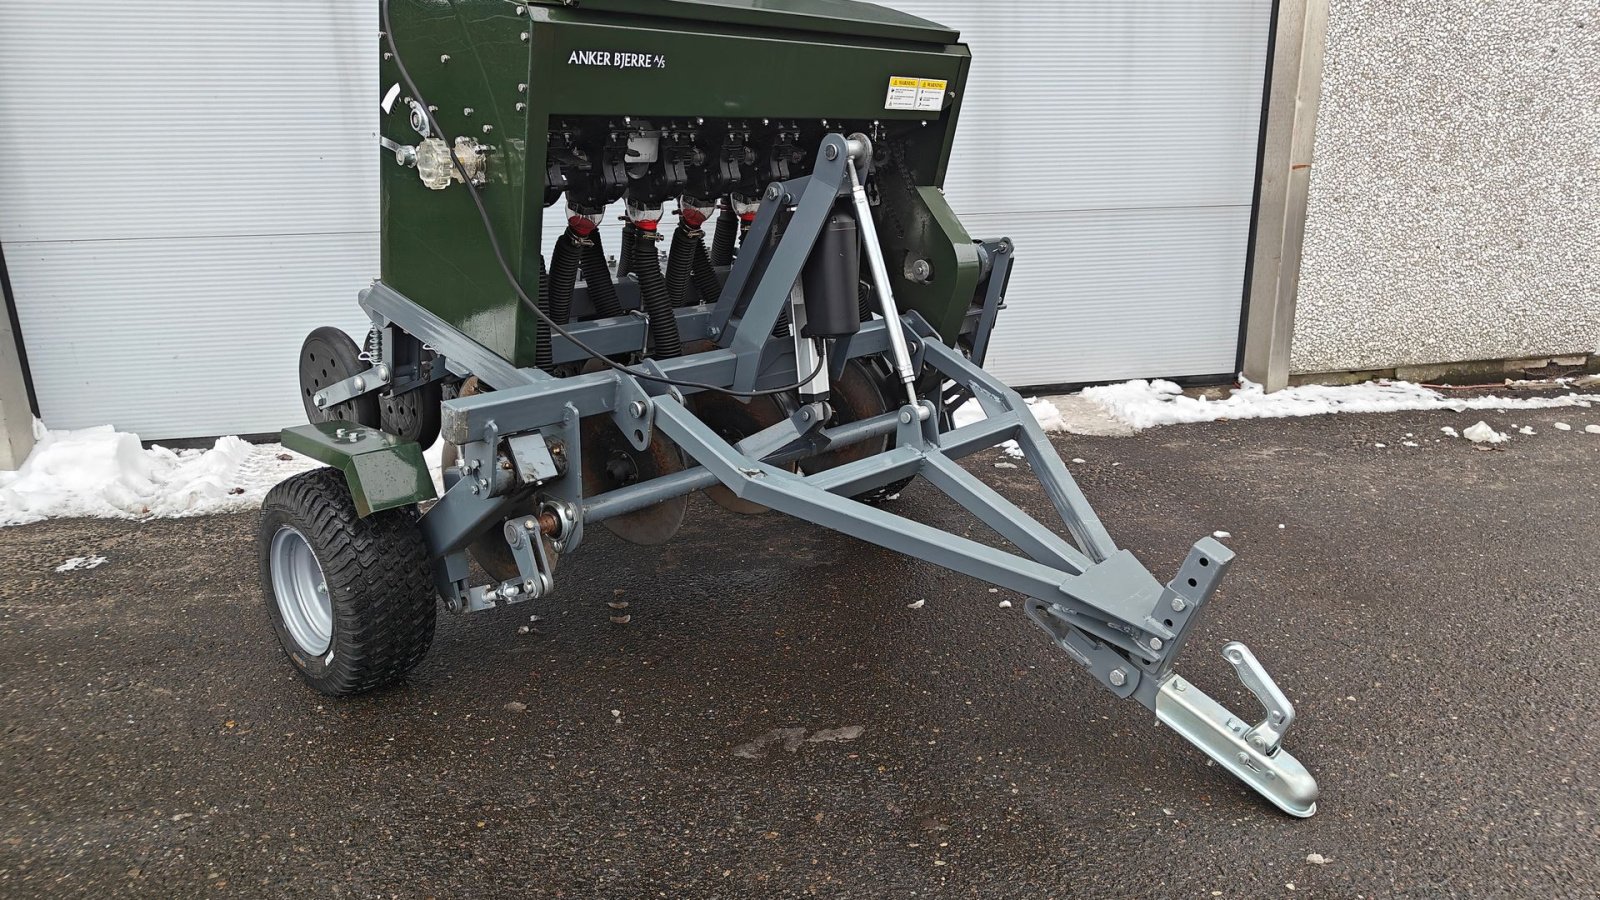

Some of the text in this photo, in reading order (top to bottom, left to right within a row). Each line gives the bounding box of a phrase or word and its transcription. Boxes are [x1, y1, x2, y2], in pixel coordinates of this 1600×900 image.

[568, 51, 665, 68] ANKER BJERRE A/S
